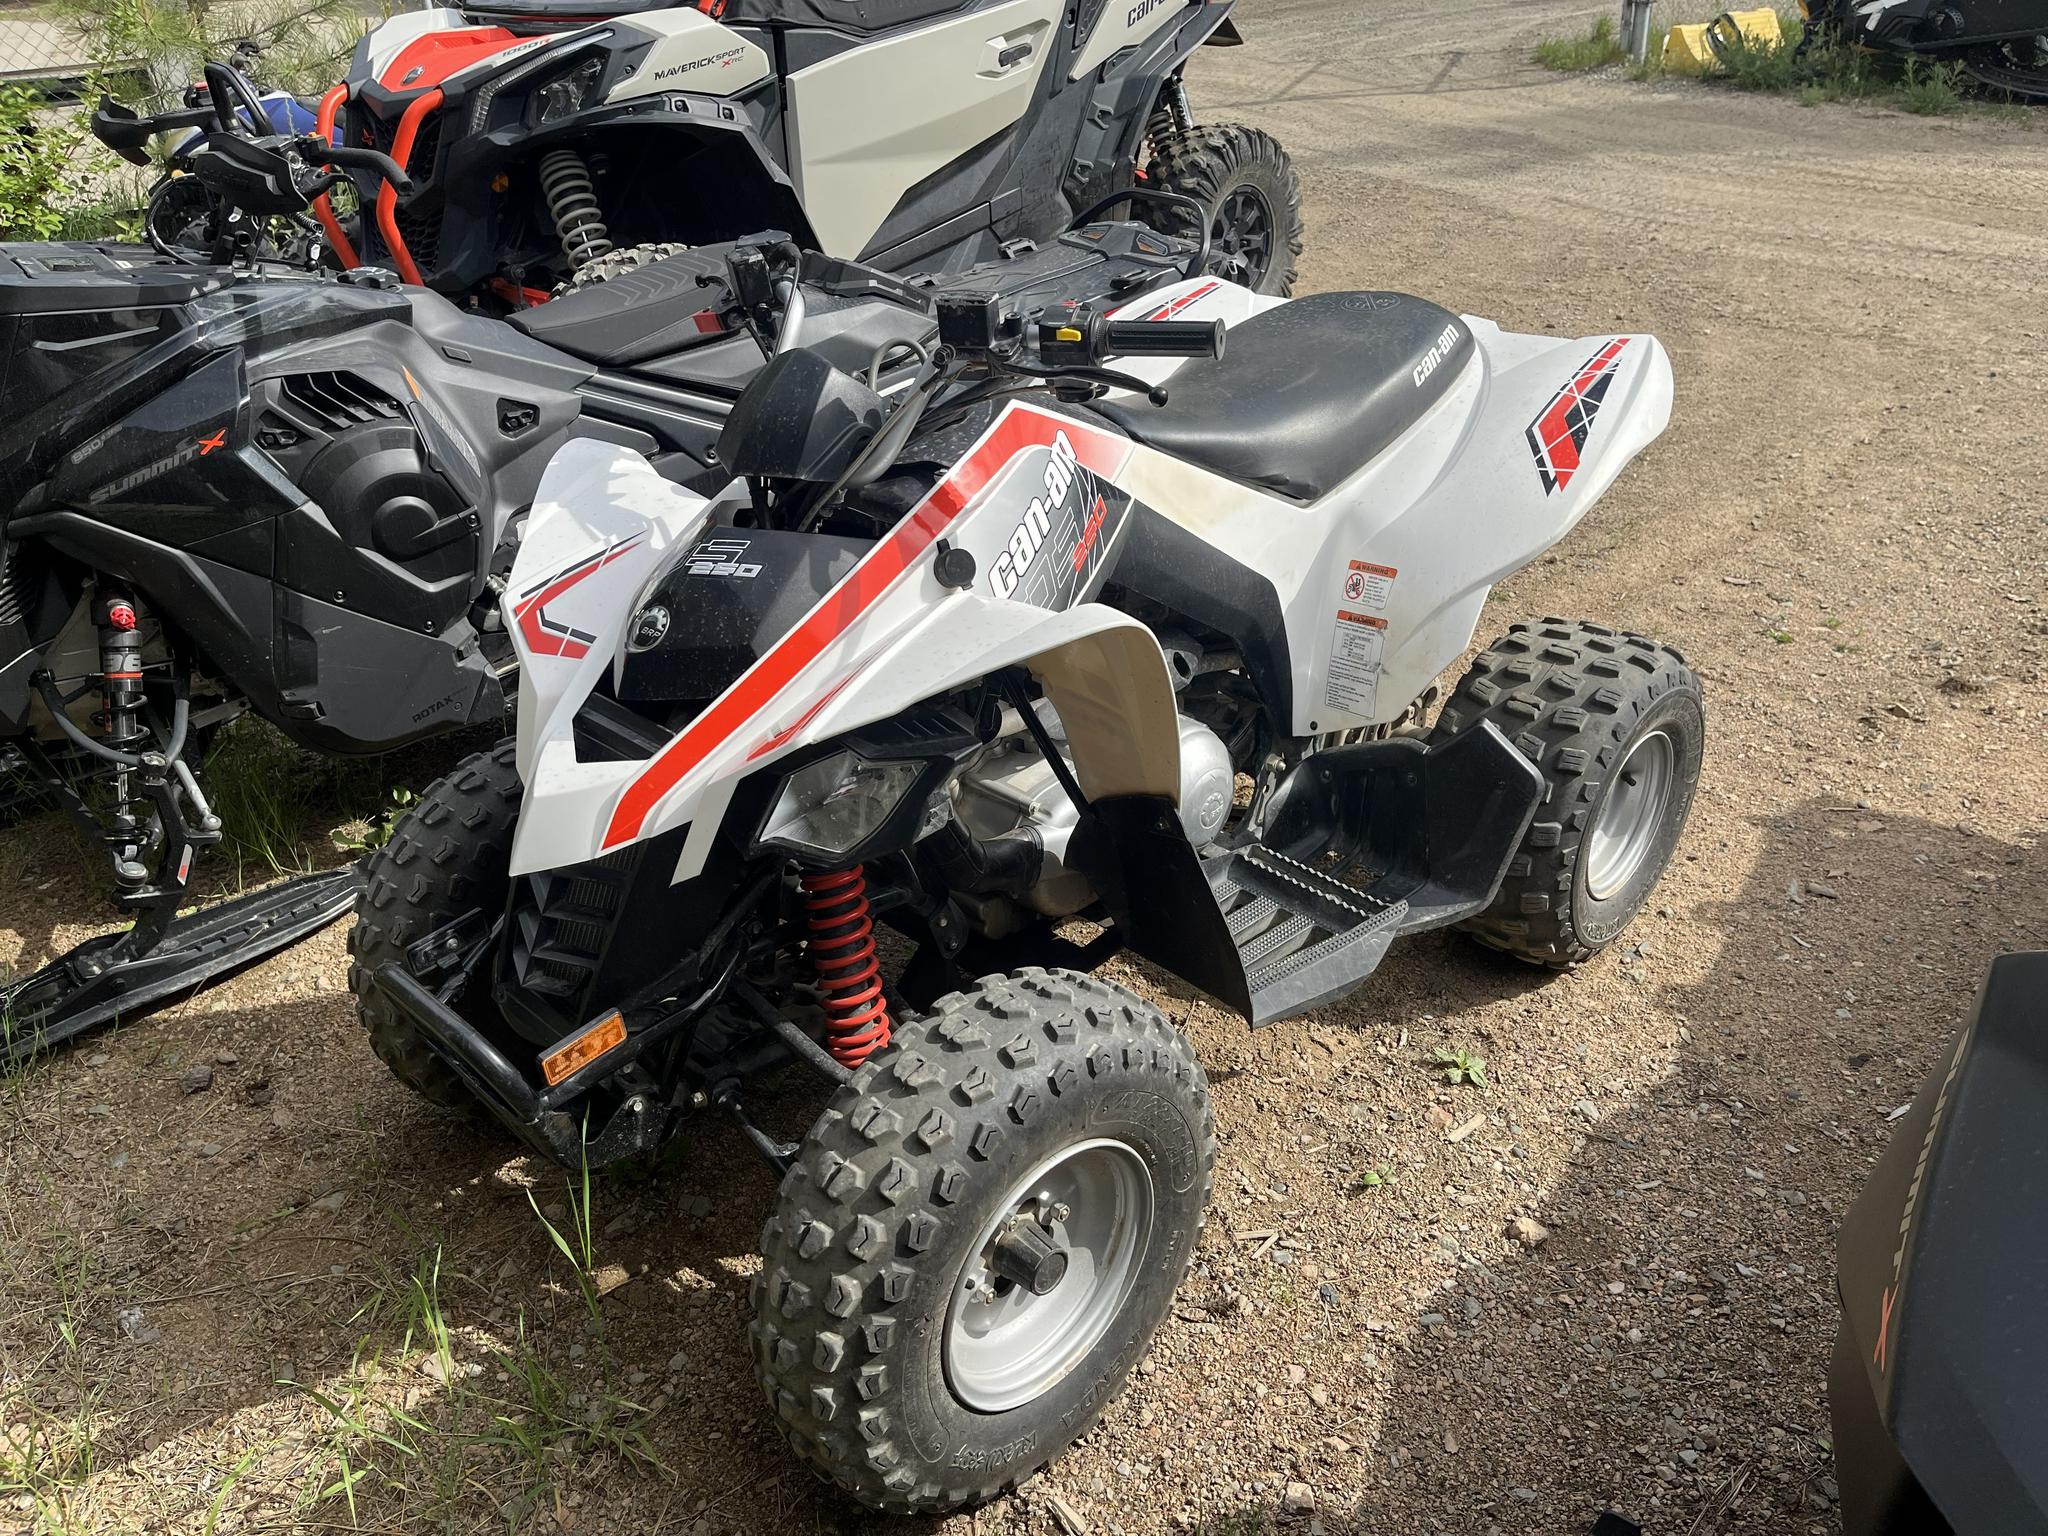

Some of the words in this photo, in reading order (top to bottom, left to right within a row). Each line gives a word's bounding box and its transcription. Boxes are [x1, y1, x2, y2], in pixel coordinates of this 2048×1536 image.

[654, 55, 716, 81] MAVERICK
[715, 46, 746, 60] SPORT
[1413, 323, 1460, 388] can-am
[71, 440, 104, 465] 850
[988, 428, 1078, 600] can-am
[1071, 496, 1108, 574] 250
[687, 560, 764, 579] 250
[1361, 564, 1390, 576] WARNING
[639, 626, 662, 639] BRP
[412, 695, 454, 723] ROTAX
[1058, 1327, 1143, 1431] KENDA
